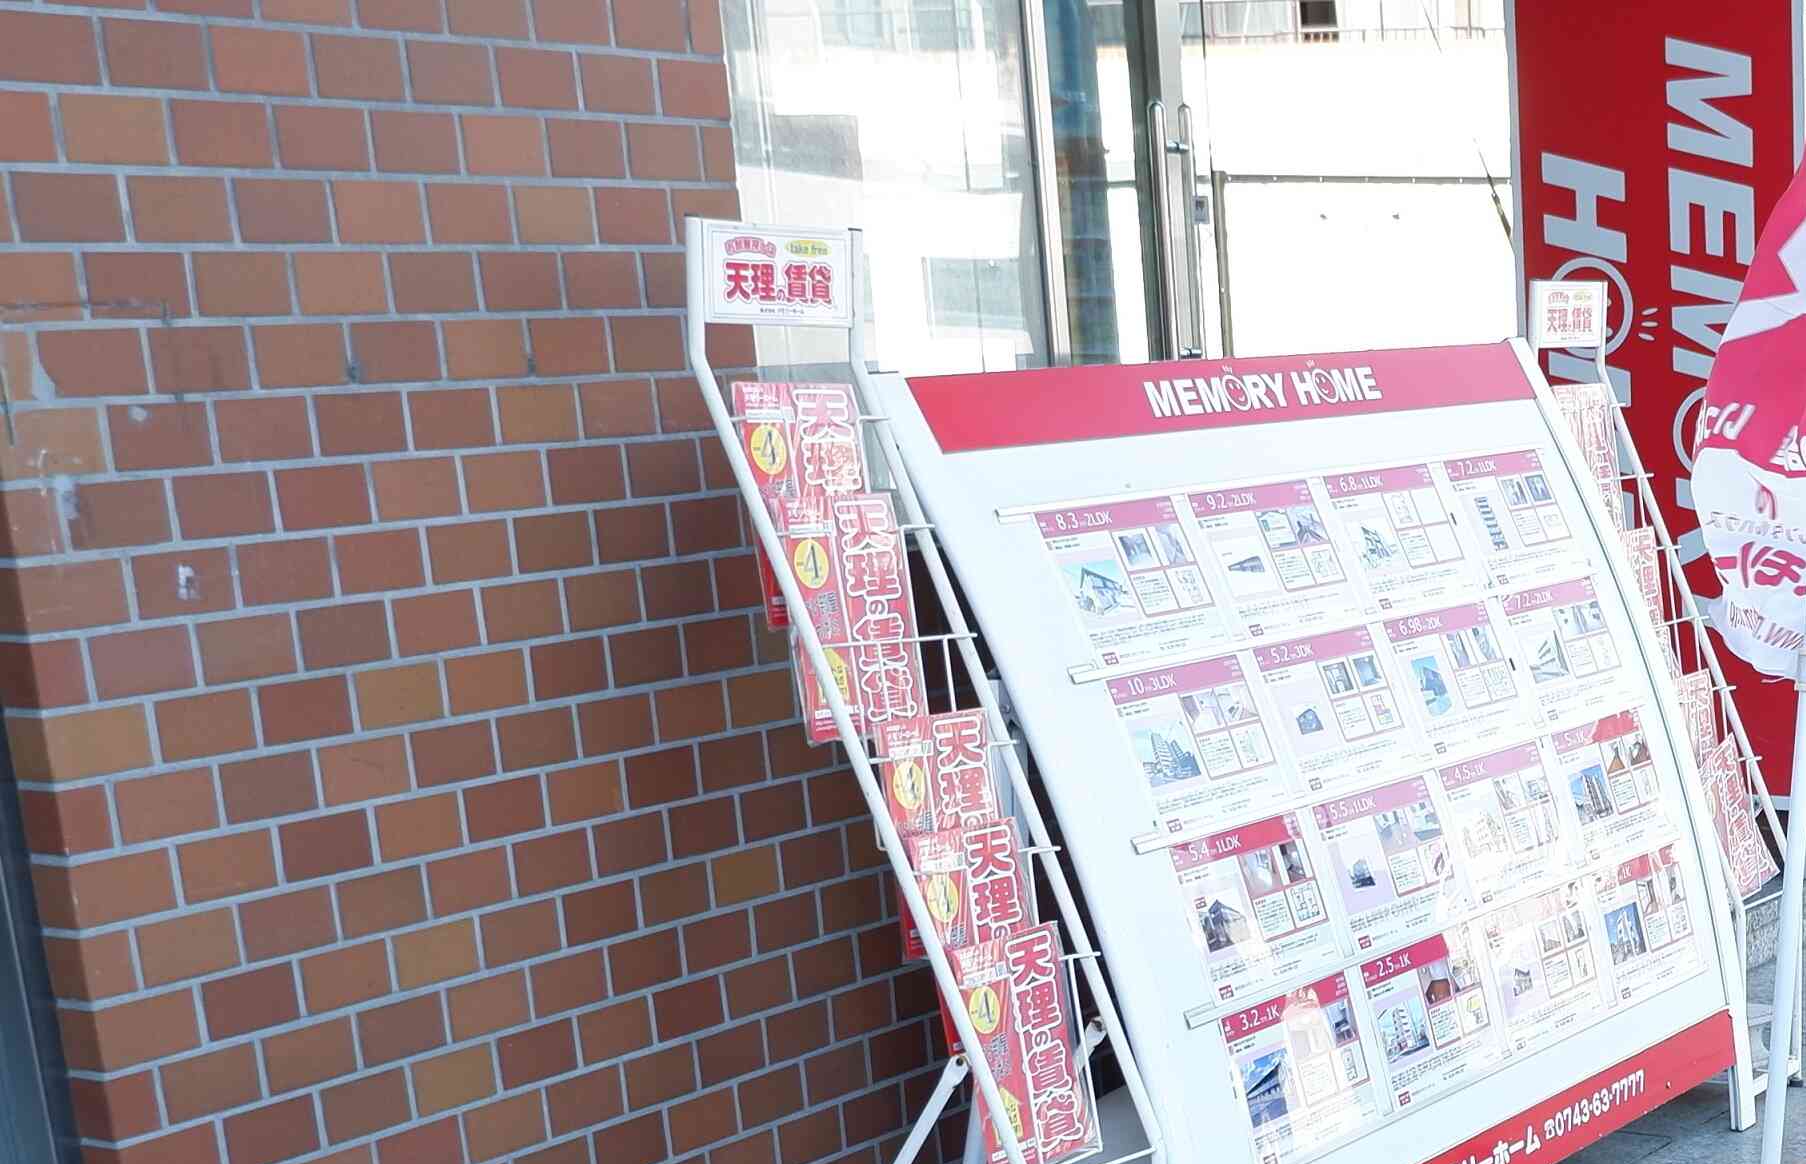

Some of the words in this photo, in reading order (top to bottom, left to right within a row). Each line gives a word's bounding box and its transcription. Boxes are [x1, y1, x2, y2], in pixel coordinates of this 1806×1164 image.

[725, 261, 833, 305] 天理の賃貸
[1144, 371, 1288, 418] MEMORY
[1290, 366, 1382, 405] HOME
